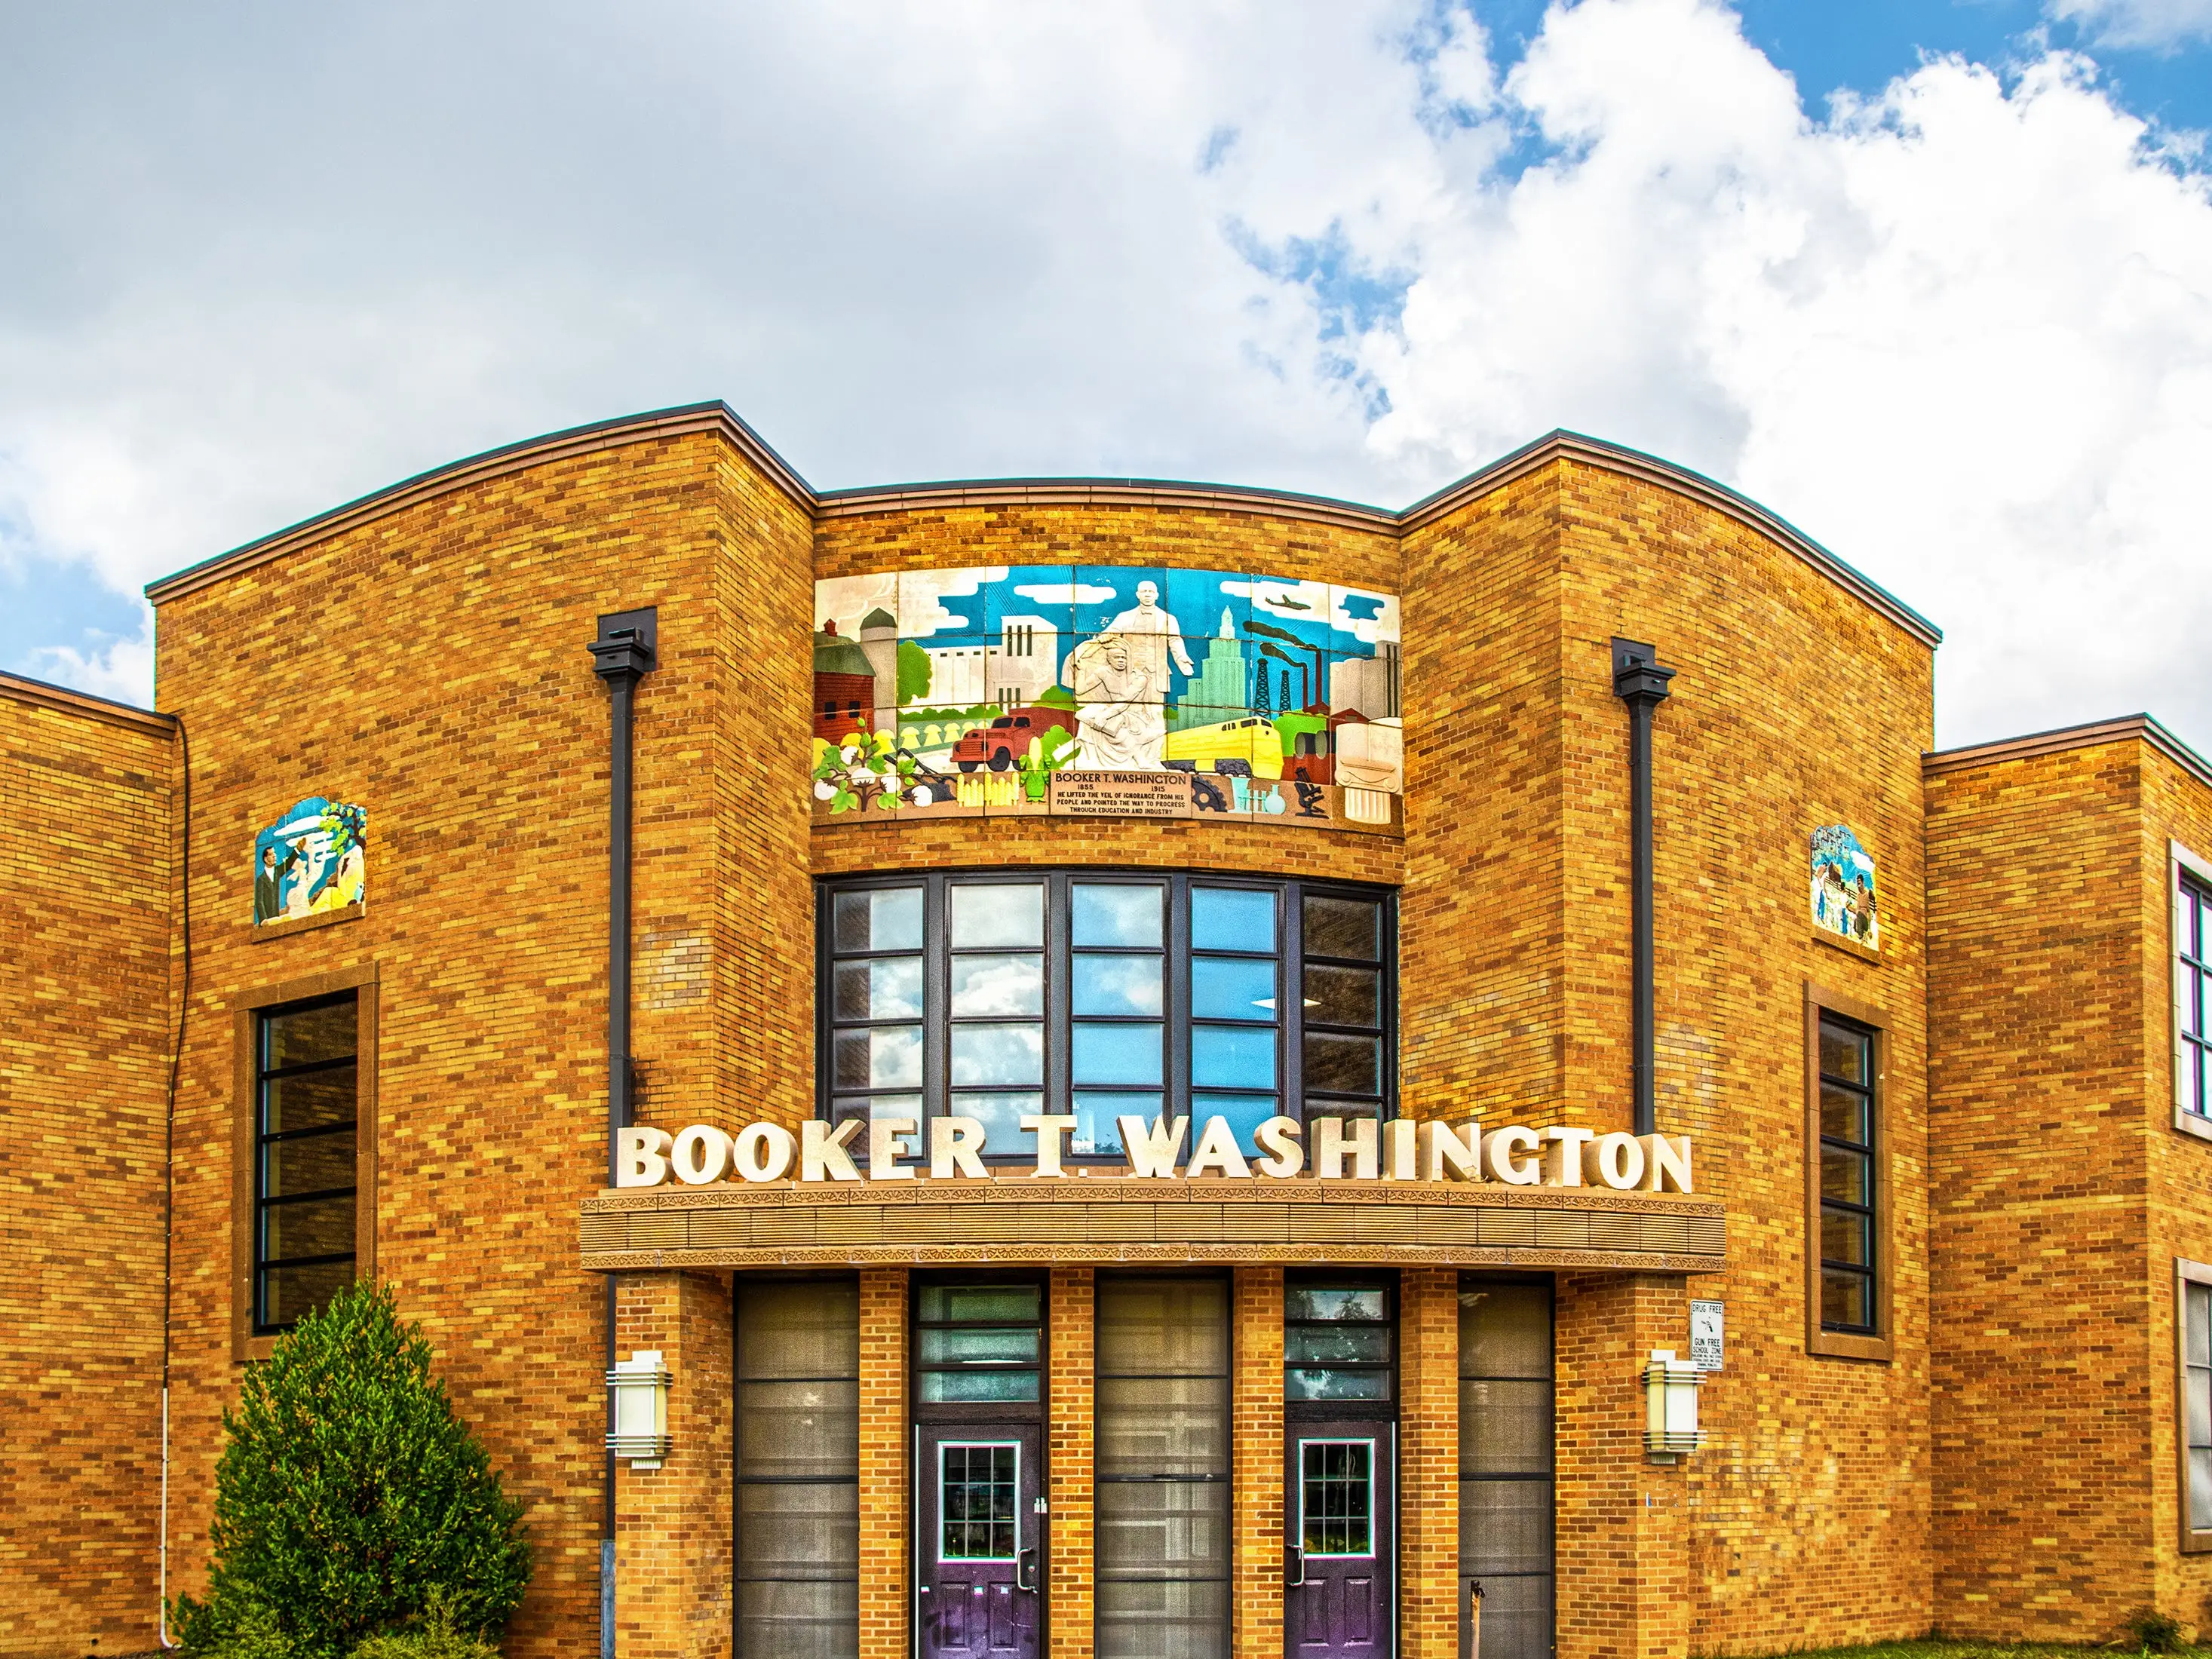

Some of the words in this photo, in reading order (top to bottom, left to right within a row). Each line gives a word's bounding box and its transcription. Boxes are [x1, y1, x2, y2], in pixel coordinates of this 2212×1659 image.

[1056, 773, 1101, 783] BOOKER
[1103, 774, 1111, 783] T.
[1112, 774, 1186, 785] WASHINGTON
[616, 1116, 992, 1188] BOOKER
[1020, 1115, 1087, 1178] T.
[1115, 1115, 1692, 1194] WASHINGTON
[1692, 1304, 1706, 1313] DRUG
[1709, 1305, 1722, 1314] FREE
[1695, 1338, 1705, 1346] GUN
[1707, 1339, 1720, 1348] FREE
